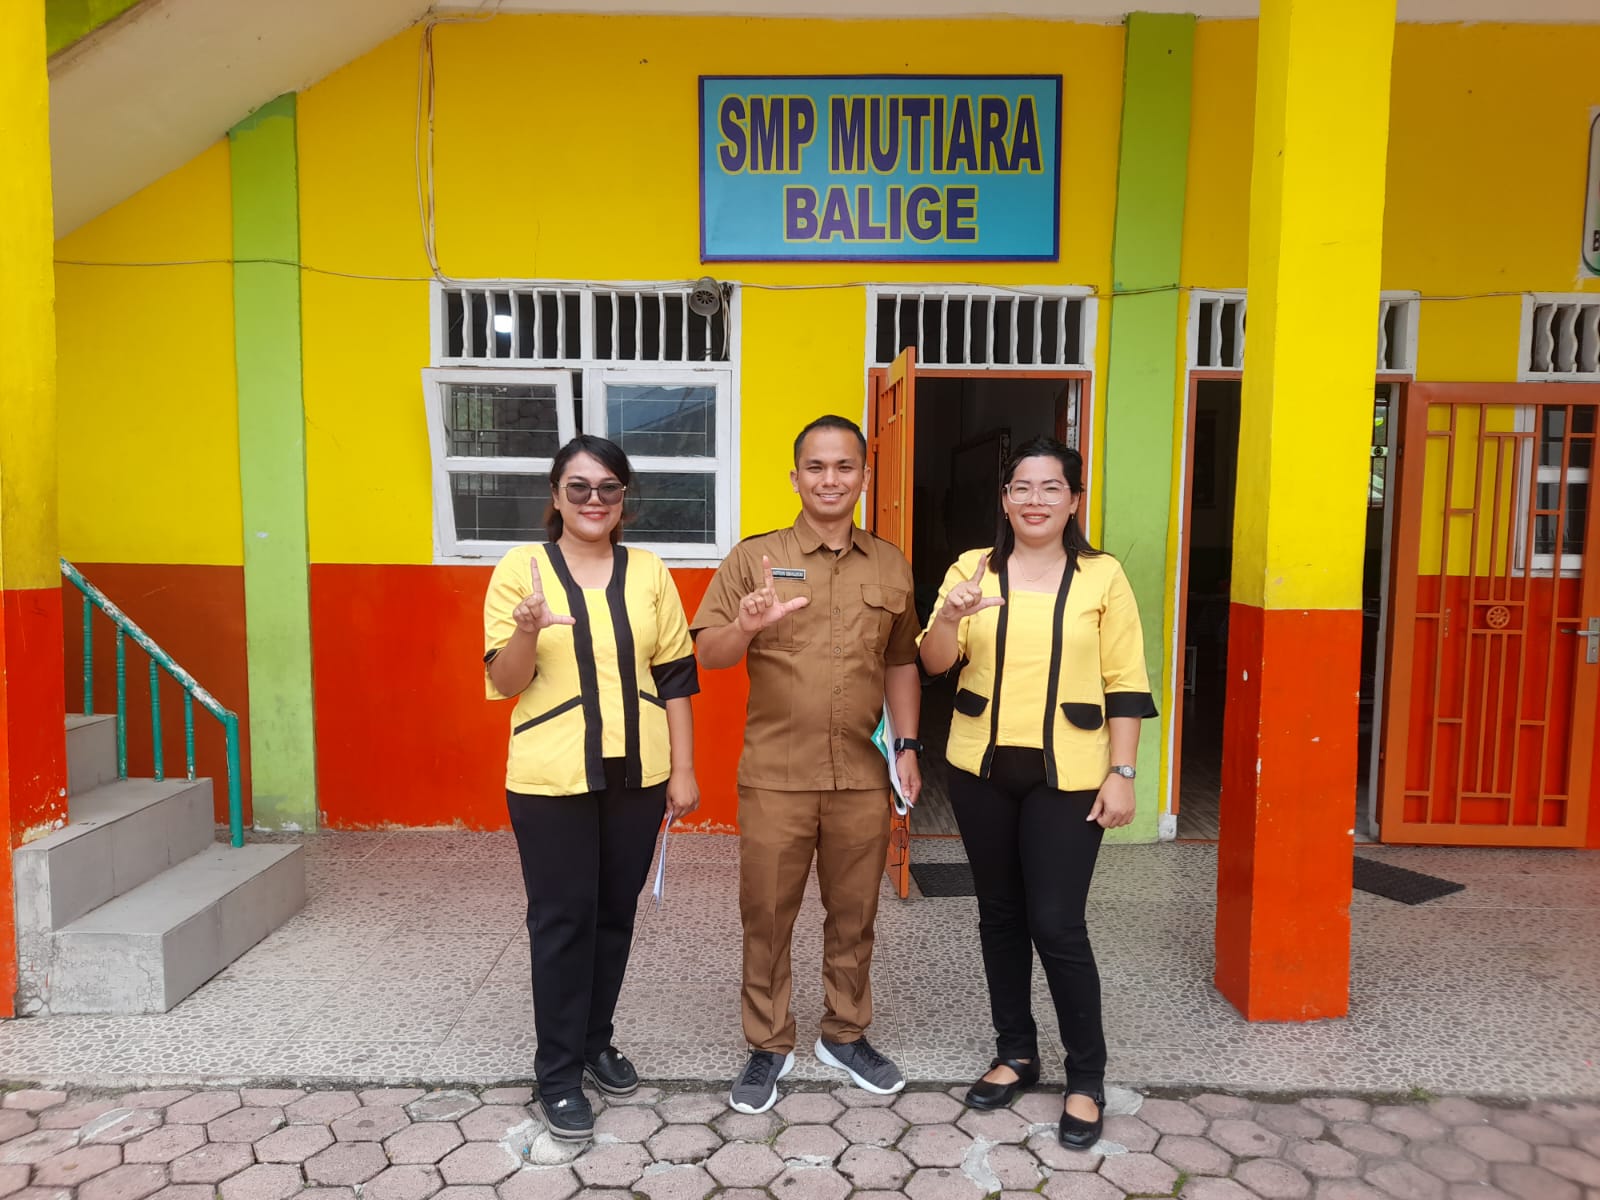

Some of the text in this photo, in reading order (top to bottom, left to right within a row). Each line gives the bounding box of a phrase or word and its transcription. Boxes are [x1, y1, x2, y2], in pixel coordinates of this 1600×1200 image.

[718, 94, 1043, 174] SMP MUTIARA
[784, 185, 978, 243] BALIGE
